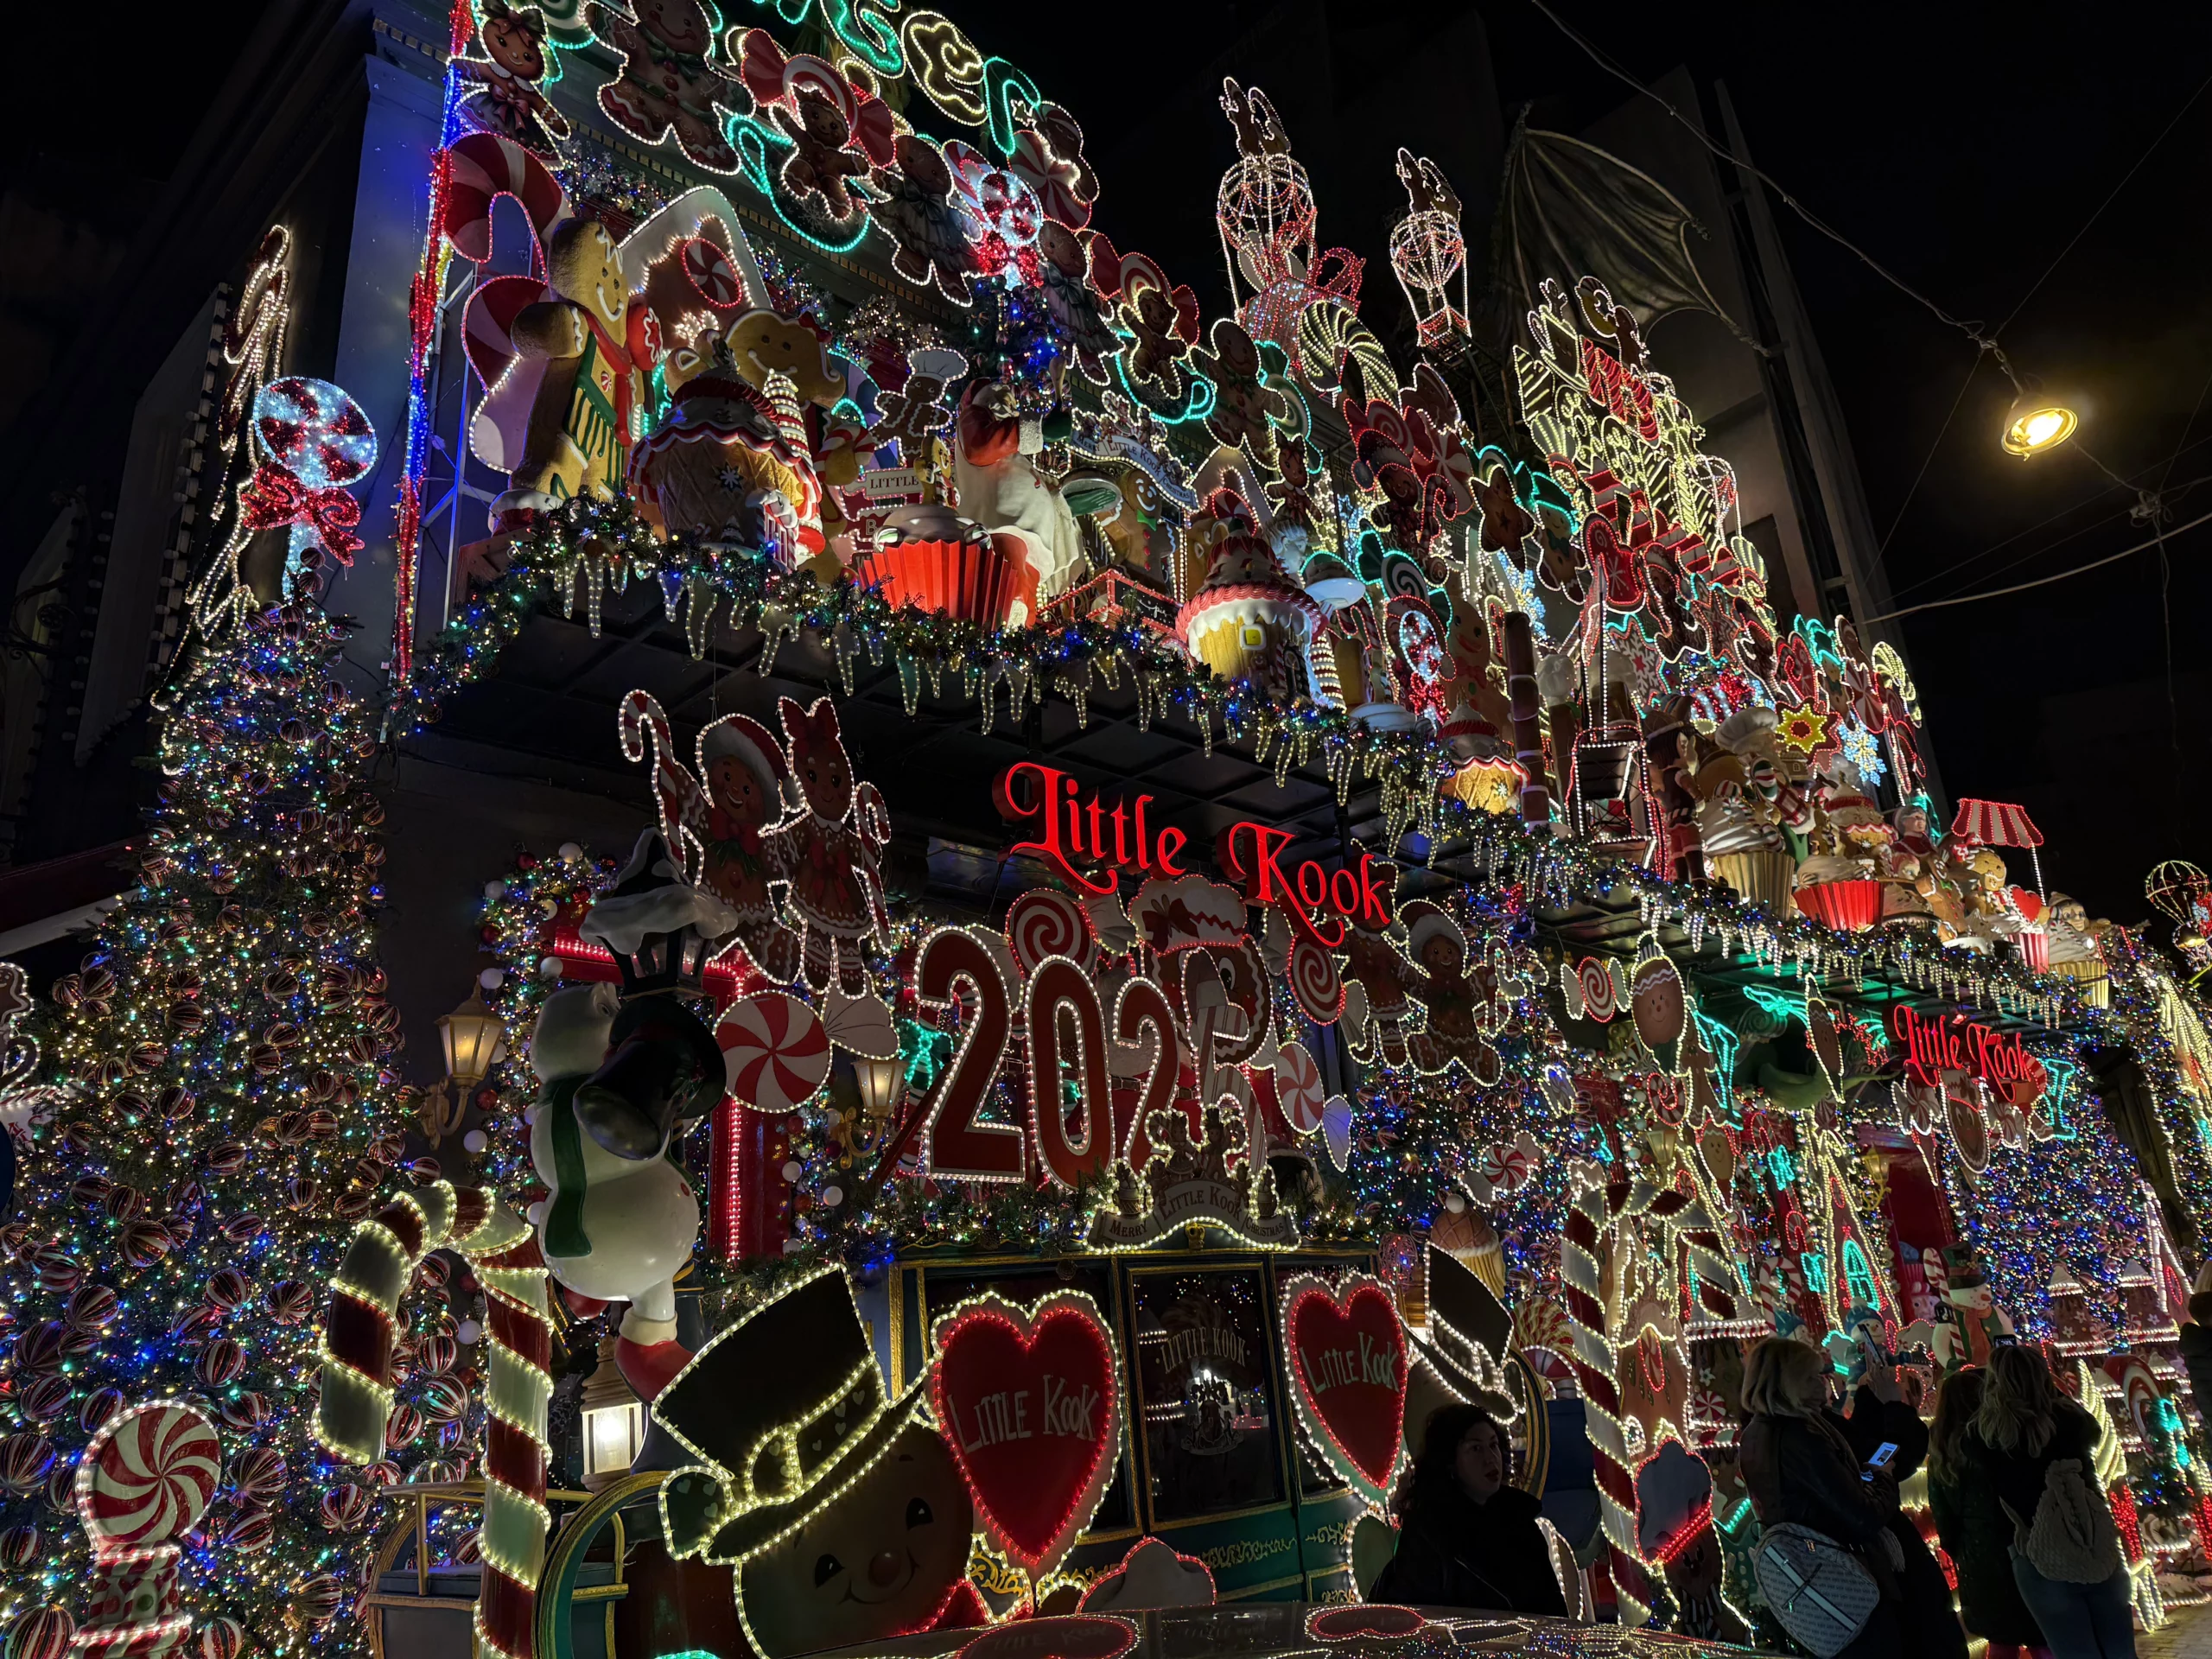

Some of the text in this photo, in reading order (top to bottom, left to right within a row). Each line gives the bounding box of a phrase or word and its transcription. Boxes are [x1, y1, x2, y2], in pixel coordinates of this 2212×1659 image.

[1108, 441, 1138, 456] LITTLE
[870, 475, 919, 490] LITTLE
[1002, 760, 1391, 947] Little Kook
[1893, 1004, 2031, 1103] Little Kook
[1163, 1185, 1242, 1222] LITTLE KOOK
[1109, 1220, 1148, 1237] MERRY
[1245, 1216, 1284, 1237] CHRISTMAS
[1160, 1326, 1246, 1375] LITTLE KOOK
[1298, 1346, 1359, 1395] LITTLE
[946, 1389, 1033, 1455] LITTLE
